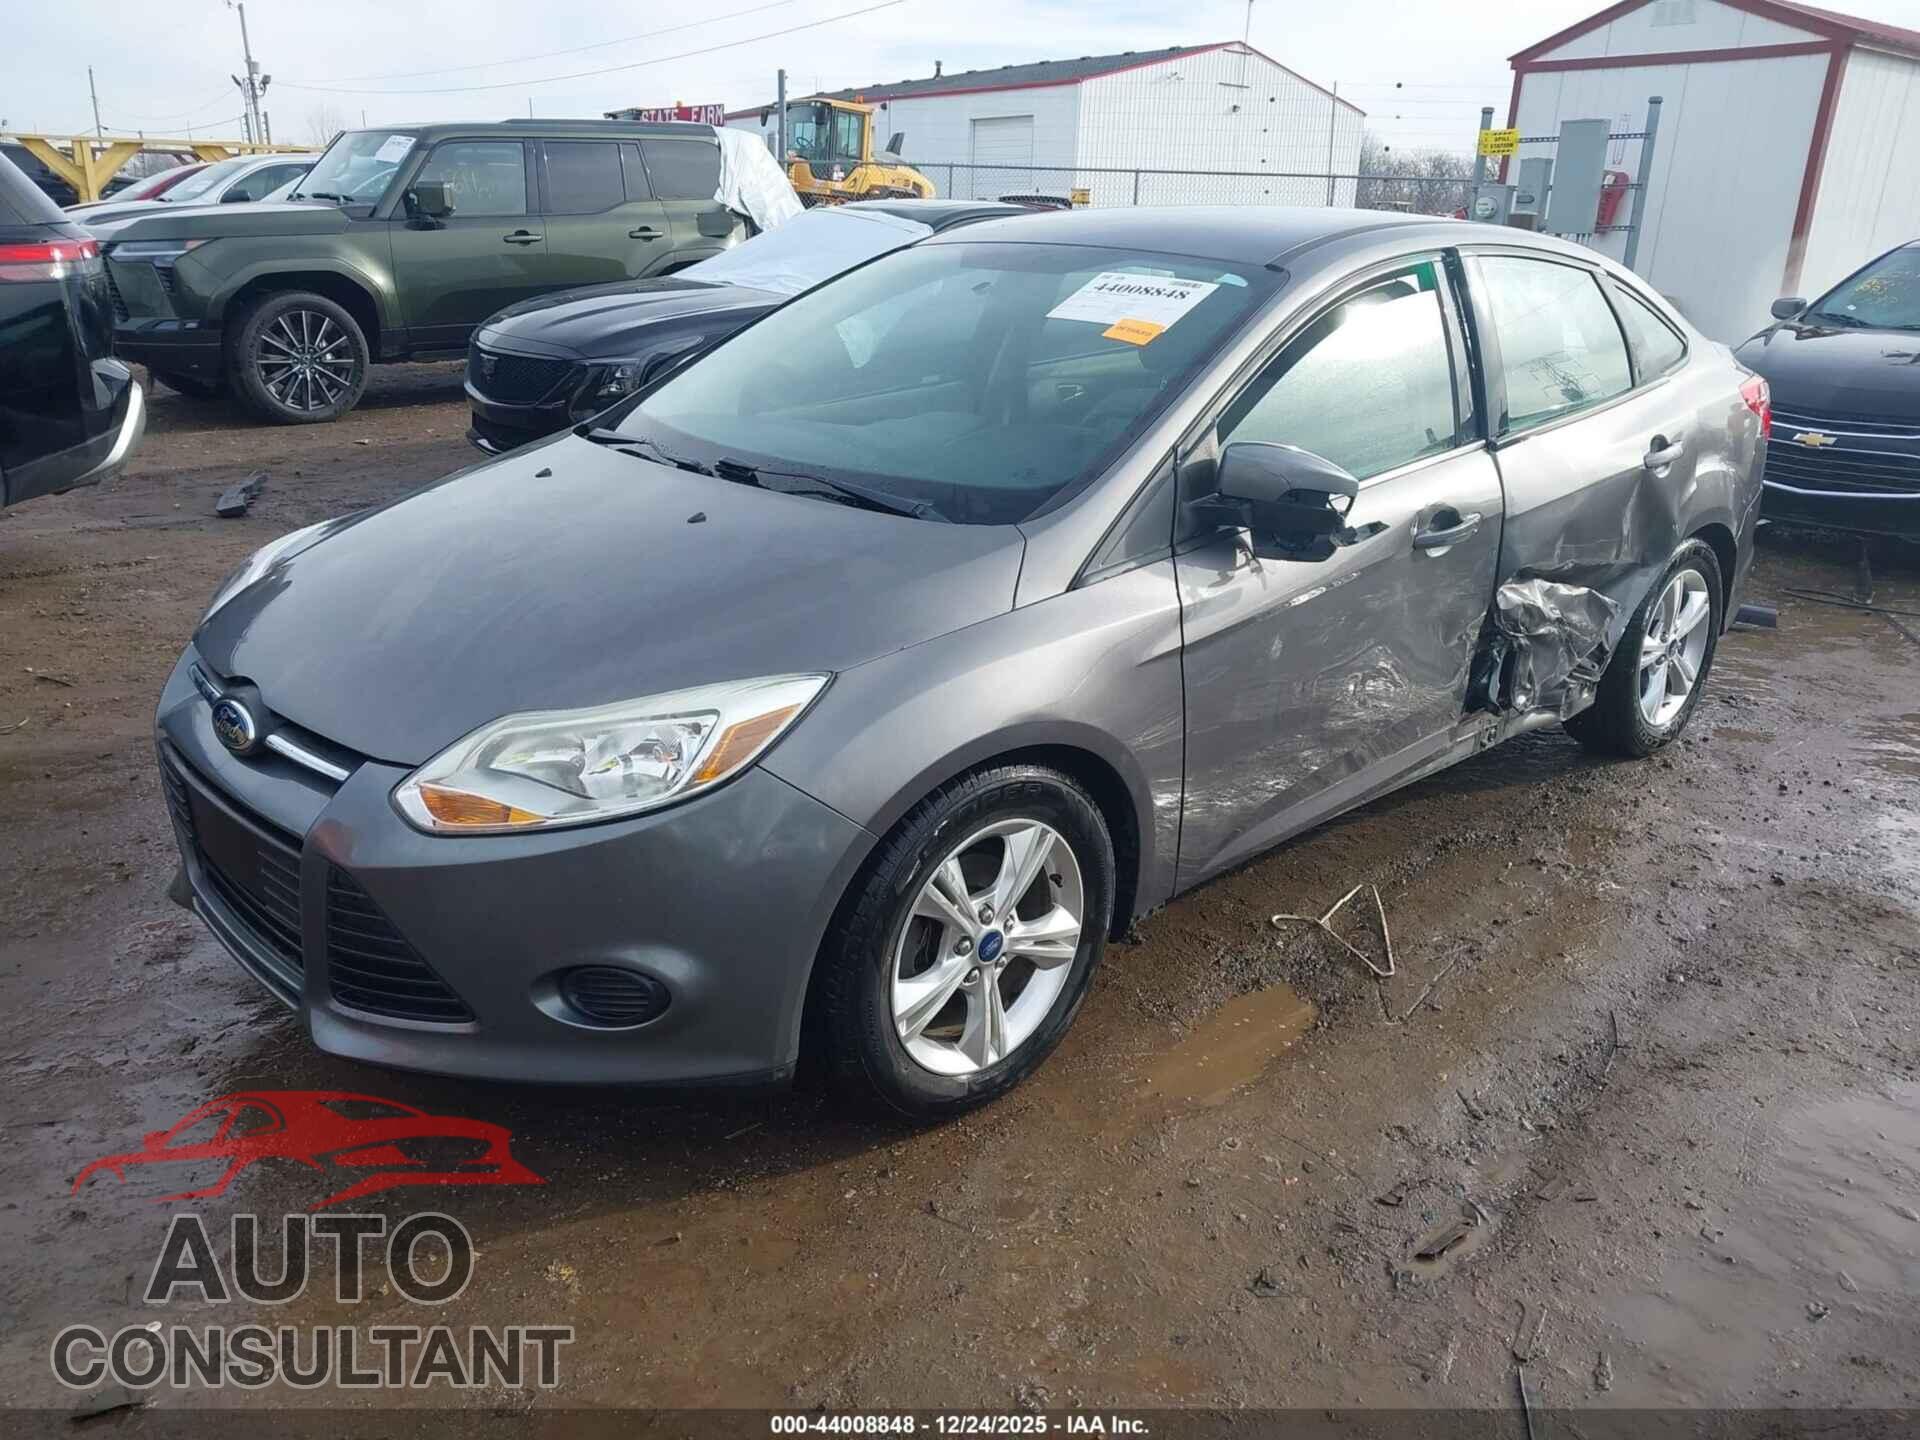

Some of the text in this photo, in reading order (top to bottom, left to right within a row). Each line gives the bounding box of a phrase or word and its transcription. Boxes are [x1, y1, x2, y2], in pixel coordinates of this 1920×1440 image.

[641, 104, 724, 126] STATE FARM
[1094, 283, 1191, 299] 44008848
